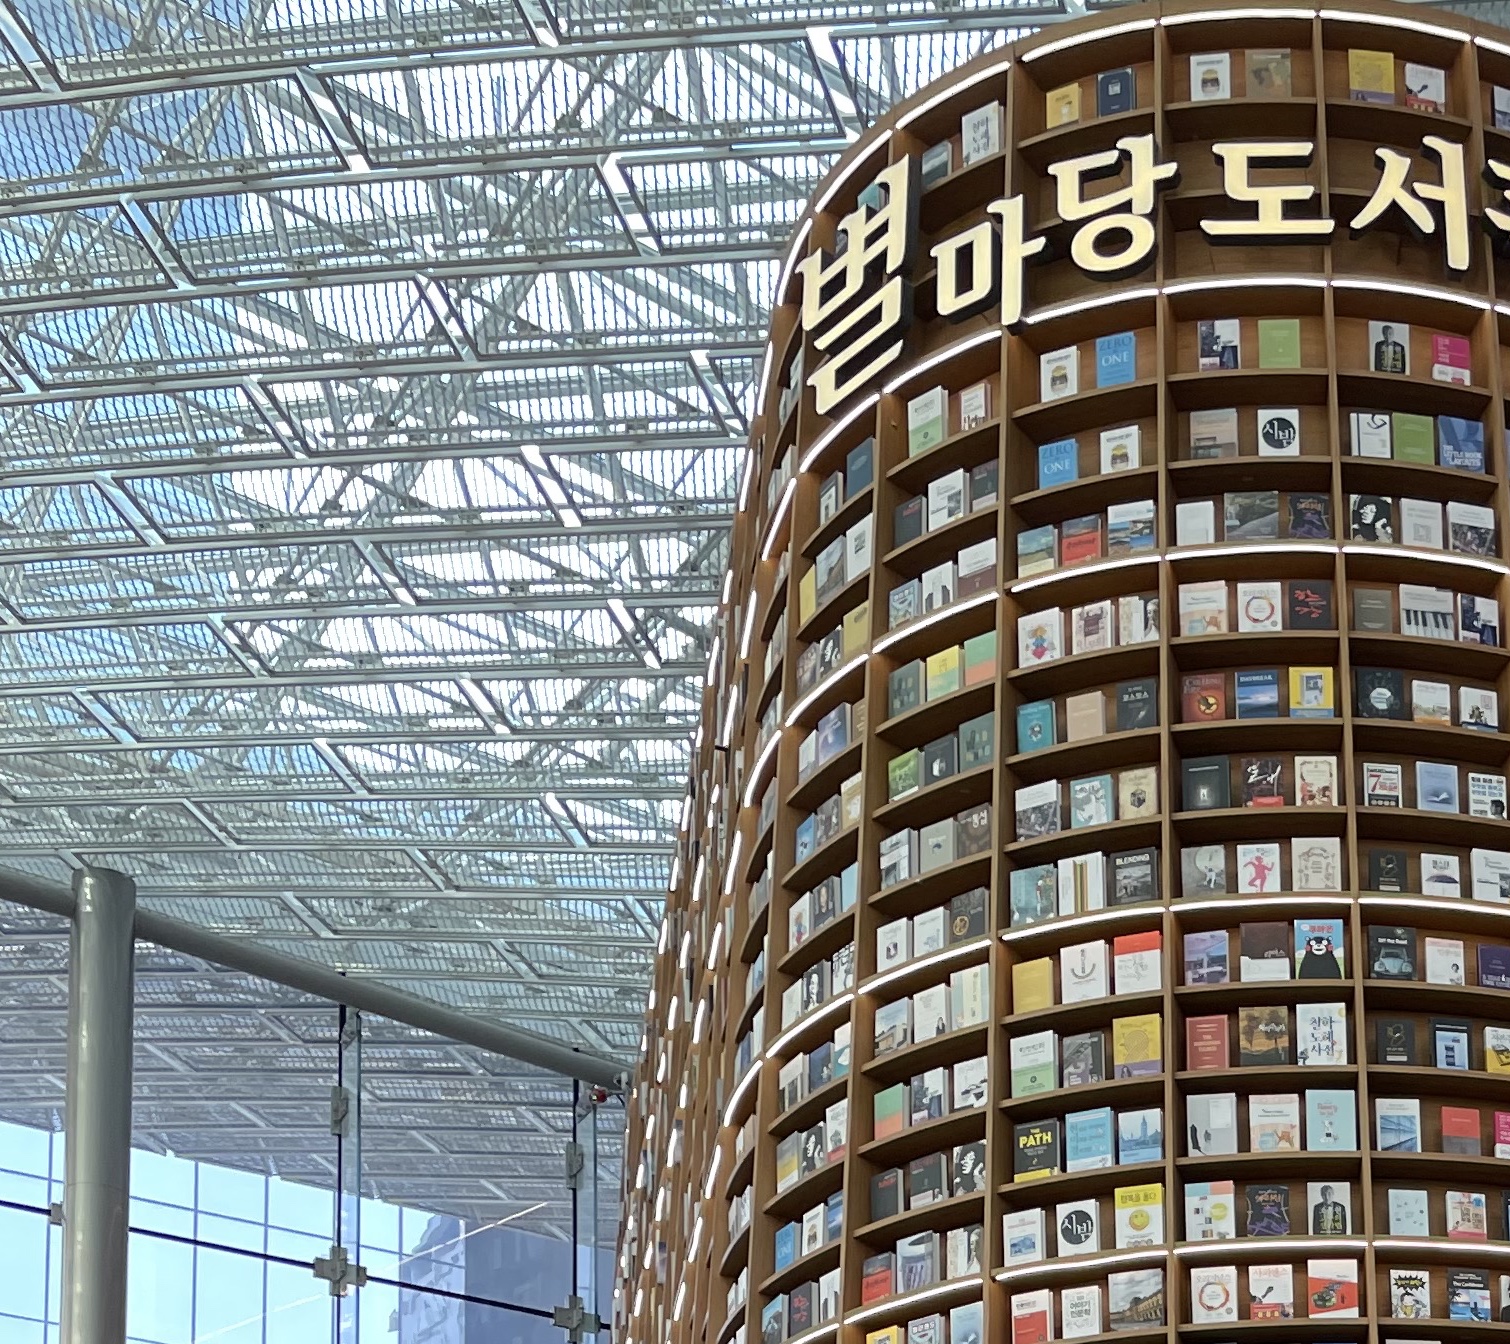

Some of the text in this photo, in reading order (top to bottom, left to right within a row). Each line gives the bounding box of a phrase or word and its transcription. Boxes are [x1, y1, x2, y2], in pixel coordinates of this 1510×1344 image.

[795, 133, 1179, 416] 별마당
[1102, 354, 1132, 366] ONE
[1044, 460, 1071, 474] ONE
[1018, 1134, 1052, 1149] PATH
